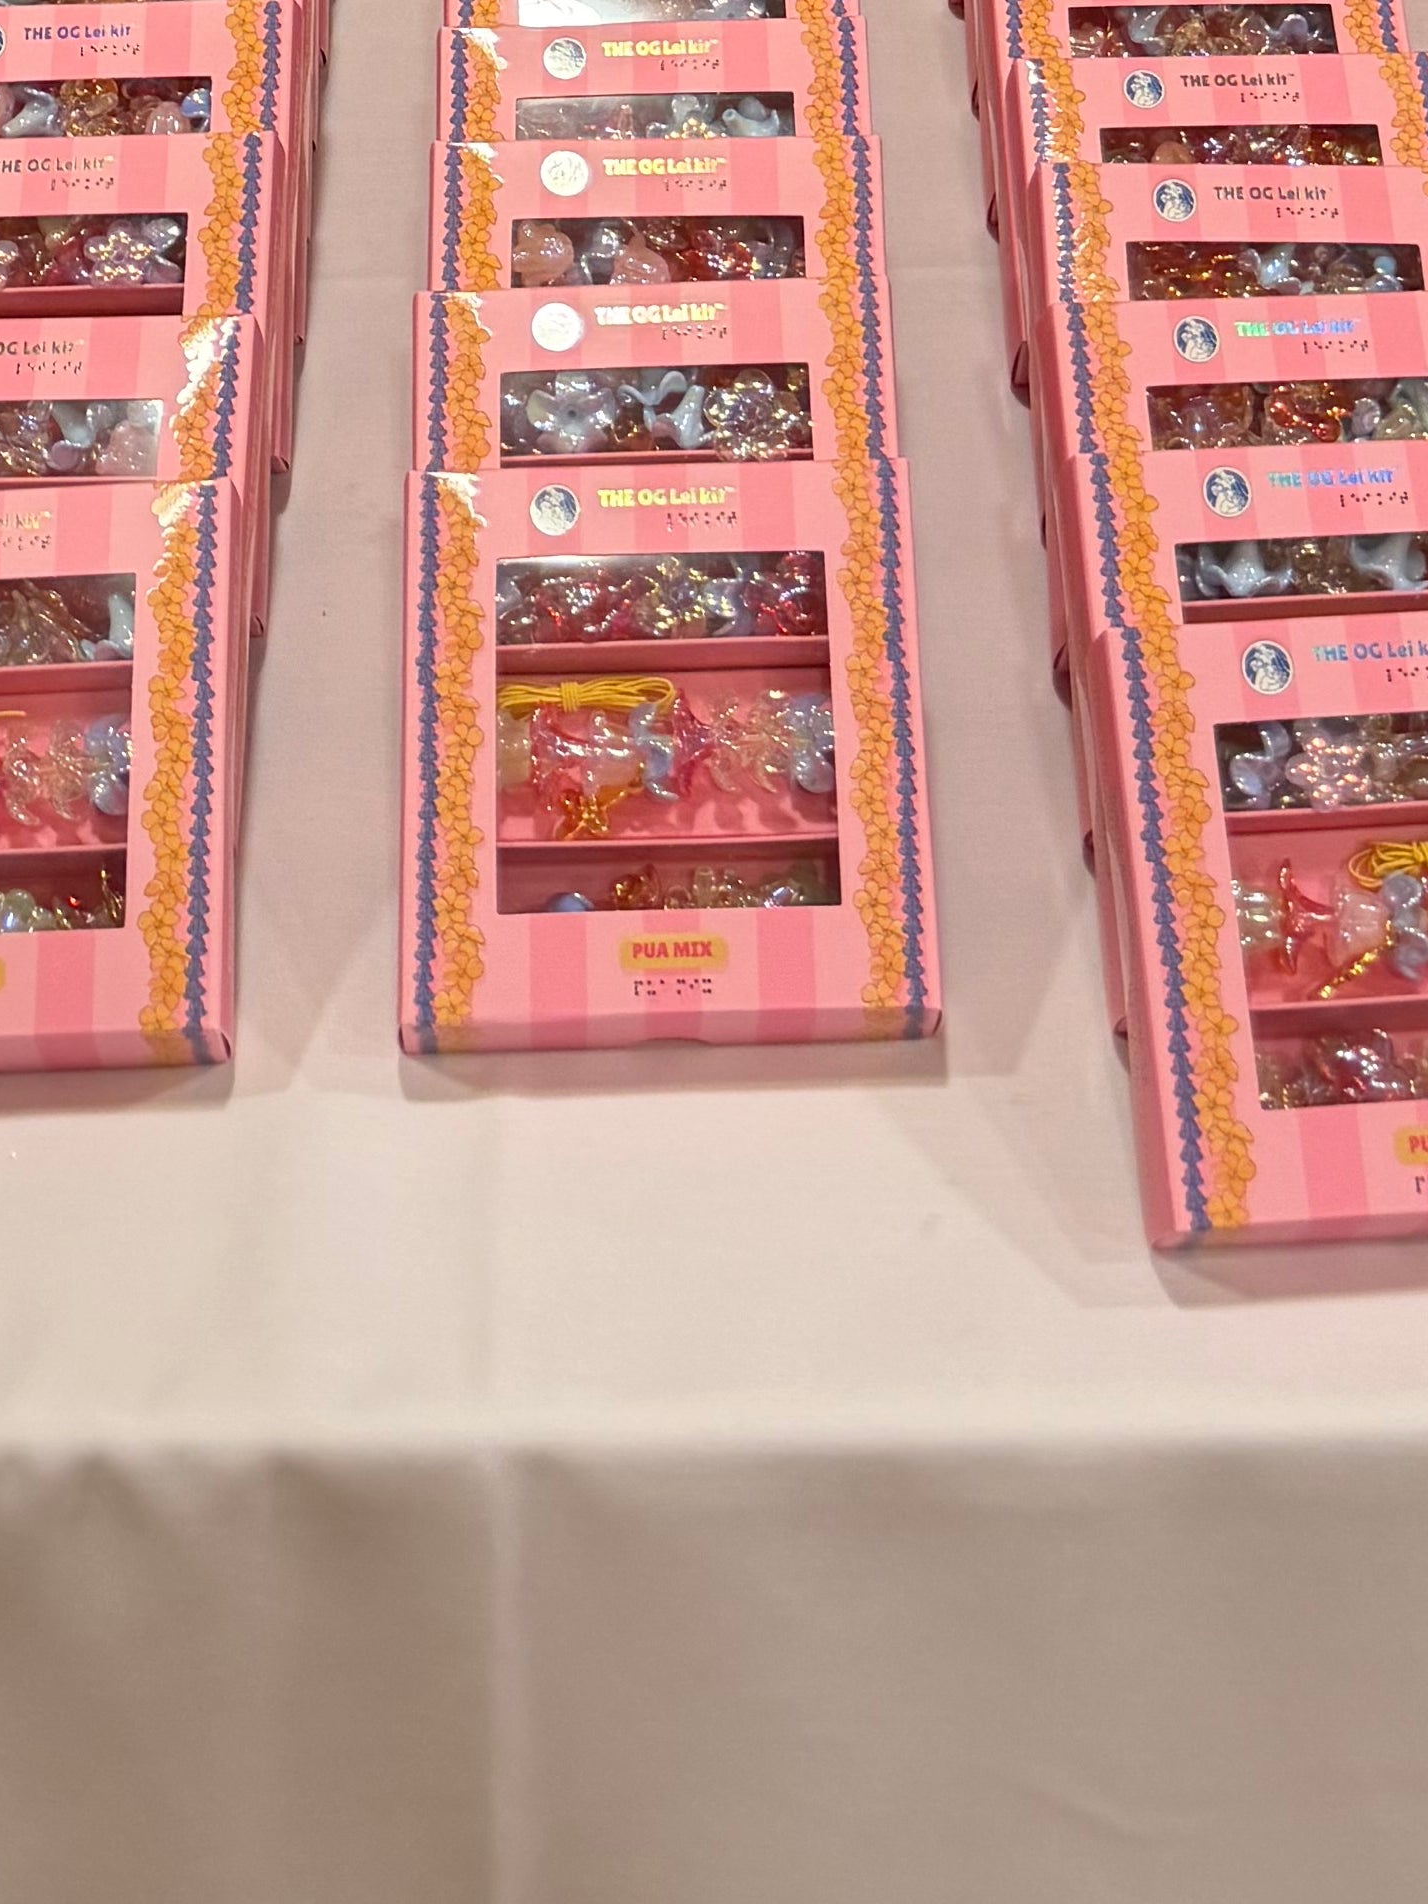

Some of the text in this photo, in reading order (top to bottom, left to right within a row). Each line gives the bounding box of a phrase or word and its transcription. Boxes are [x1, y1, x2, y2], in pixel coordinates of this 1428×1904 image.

[24, 27, 52, 40] THE
[57, 25, 80, 39] OG
[85, 25, 106, 38] Lei
[1180, 75, 1210, 88] THE
[1214, 74, 1238, 87] OG
[1241, 73, 1263, 86] Lei
[1213, 186, 1244, 200] THE
[1249, 186, 1274, 200] OG
[1278, 186, 1300, 200] Lei
[1313, 644, 1349, 661] THE
[1354, 643, 1382, 659] OG
[1387, 641, 1414, 658] Lei
[633, 941, 712, 959] PUA MIX
